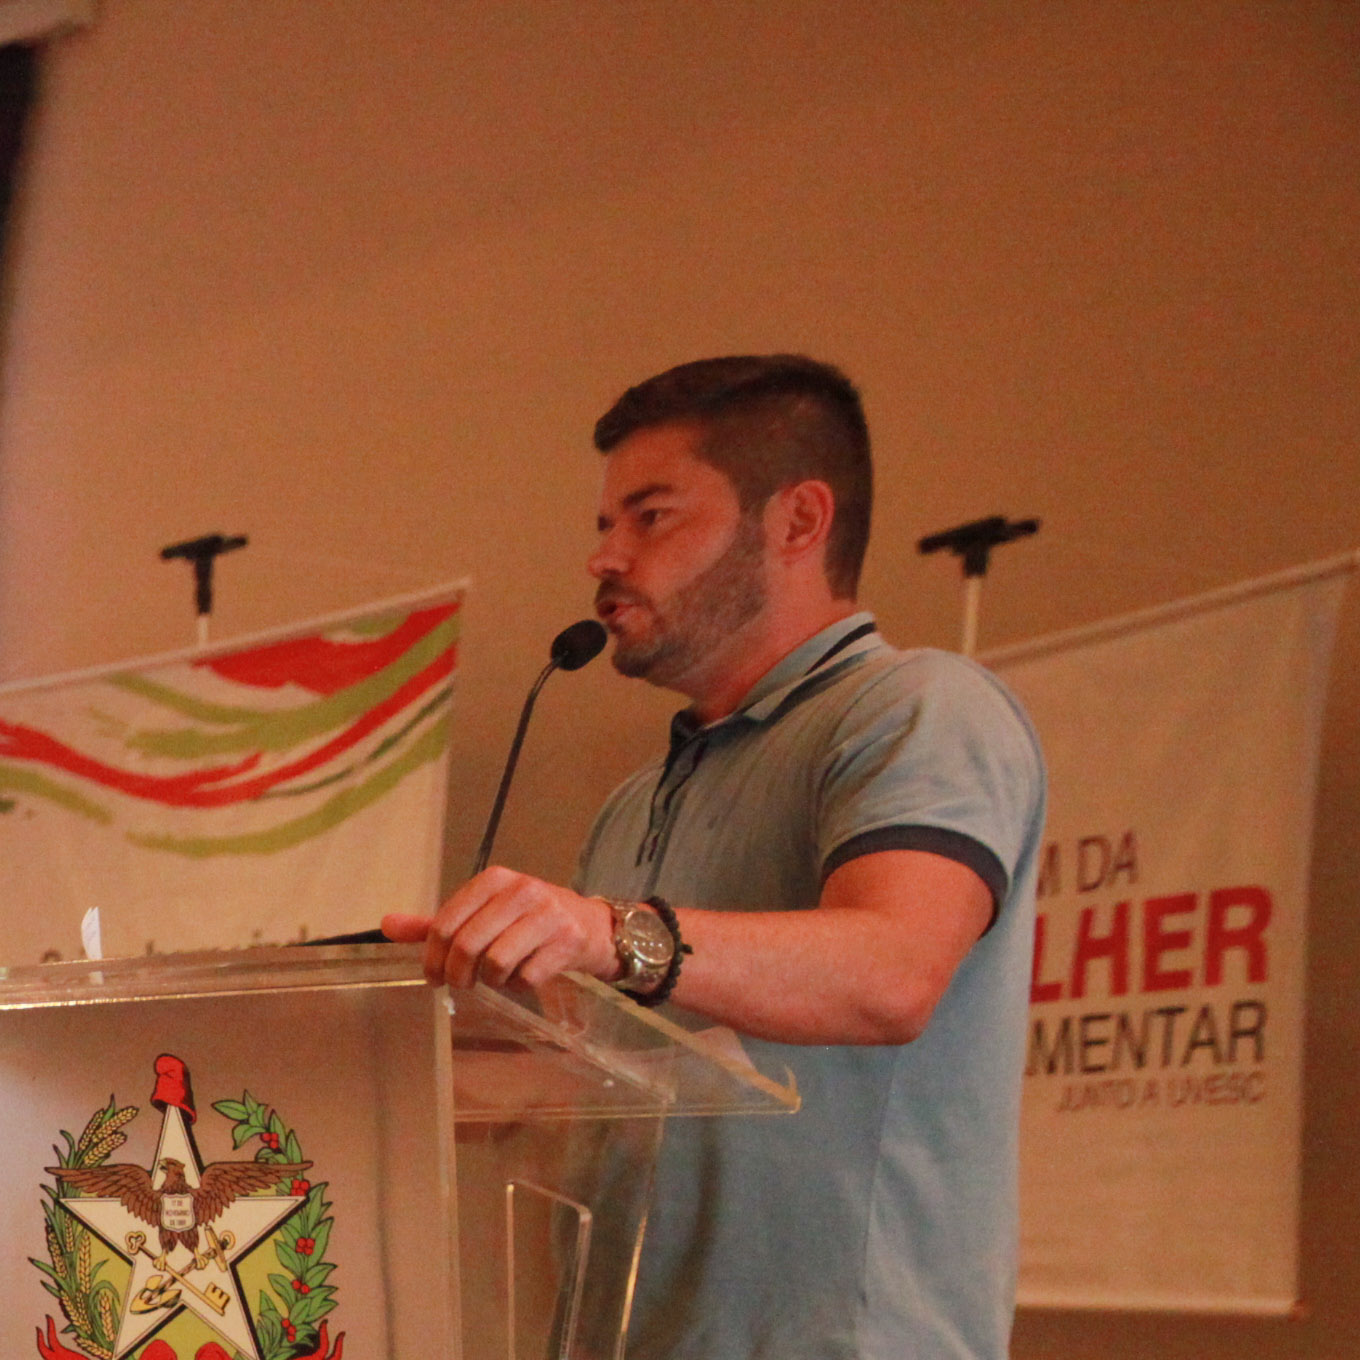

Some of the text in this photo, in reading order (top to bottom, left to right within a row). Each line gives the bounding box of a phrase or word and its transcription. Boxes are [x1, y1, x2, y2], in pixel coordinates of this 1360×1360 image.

[1076, 829, 1139, 895] DA
[1029, 886, 1273, 1005] LHER
[1025, 1000, 1268, 1077] MENTAR
